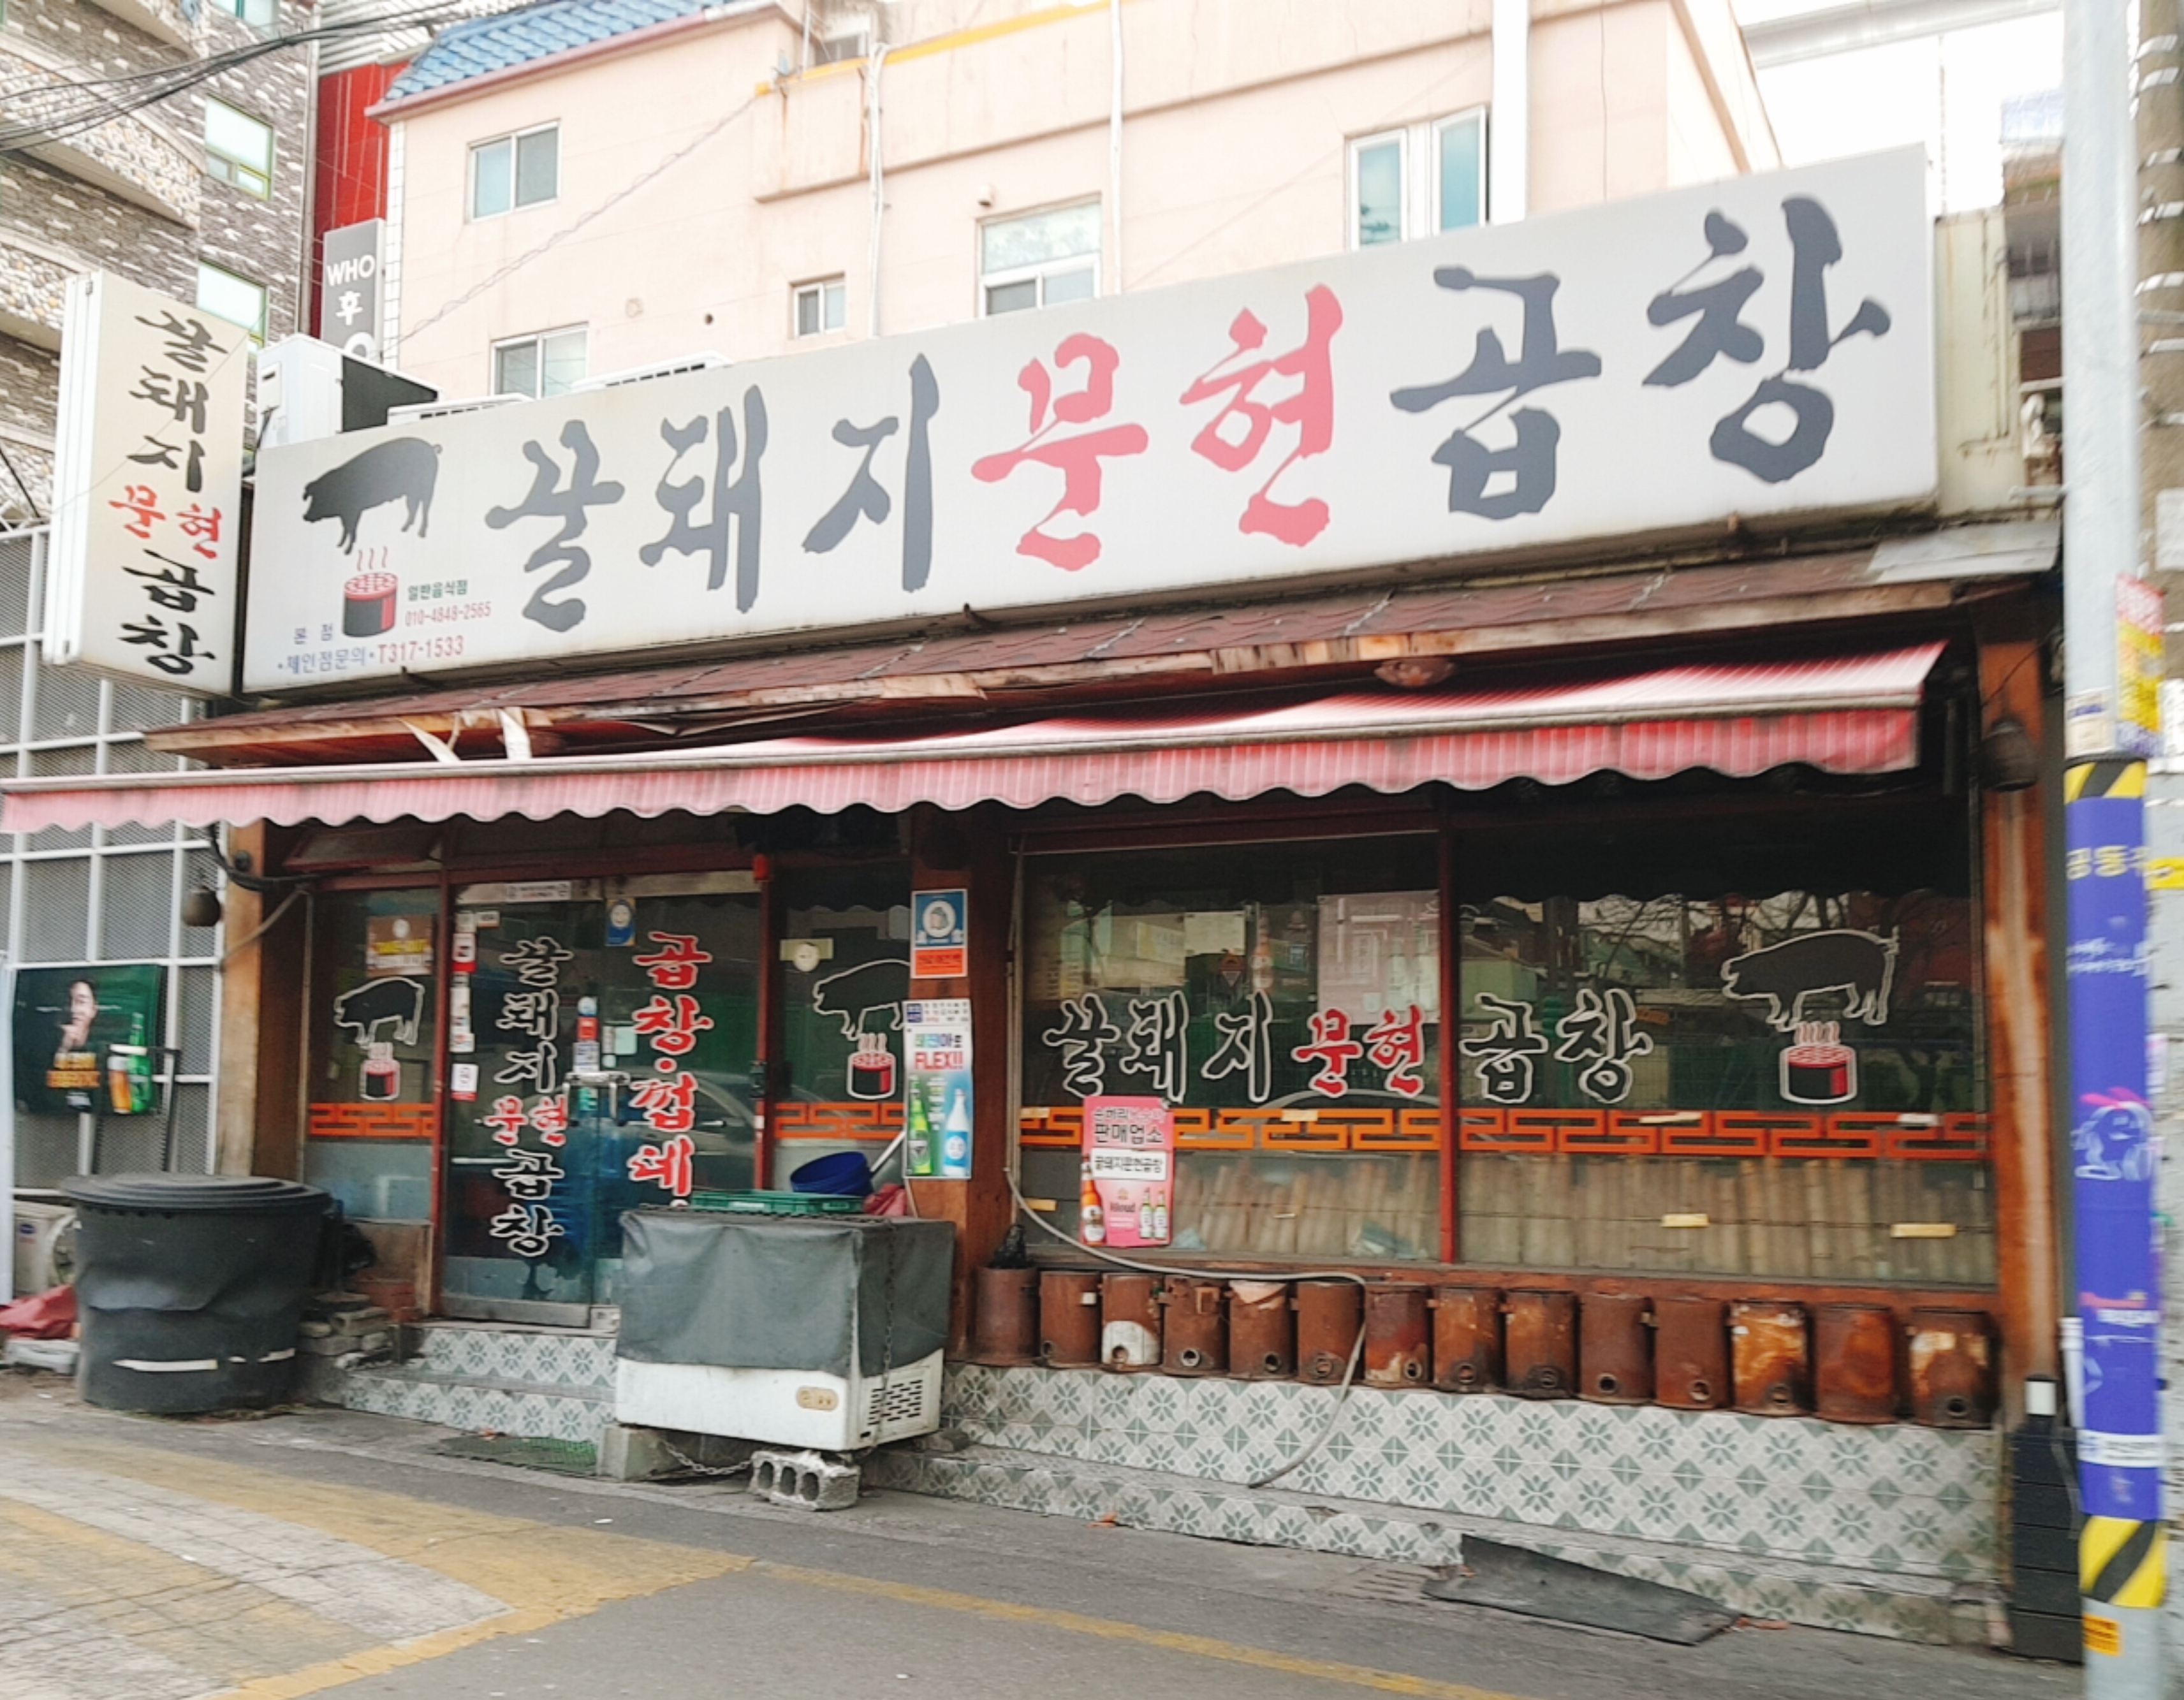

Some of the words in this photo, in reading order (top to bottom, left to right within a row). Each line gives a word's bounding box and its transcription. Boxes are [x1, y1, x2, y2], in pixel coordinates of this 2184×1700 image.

[326, 254, 376, 287] WHO
[335, 290, 363, 326] 후
[407, 579, 468, 602] 일반음식점
[1094, 1123, 1164, 1145] 판매업소
